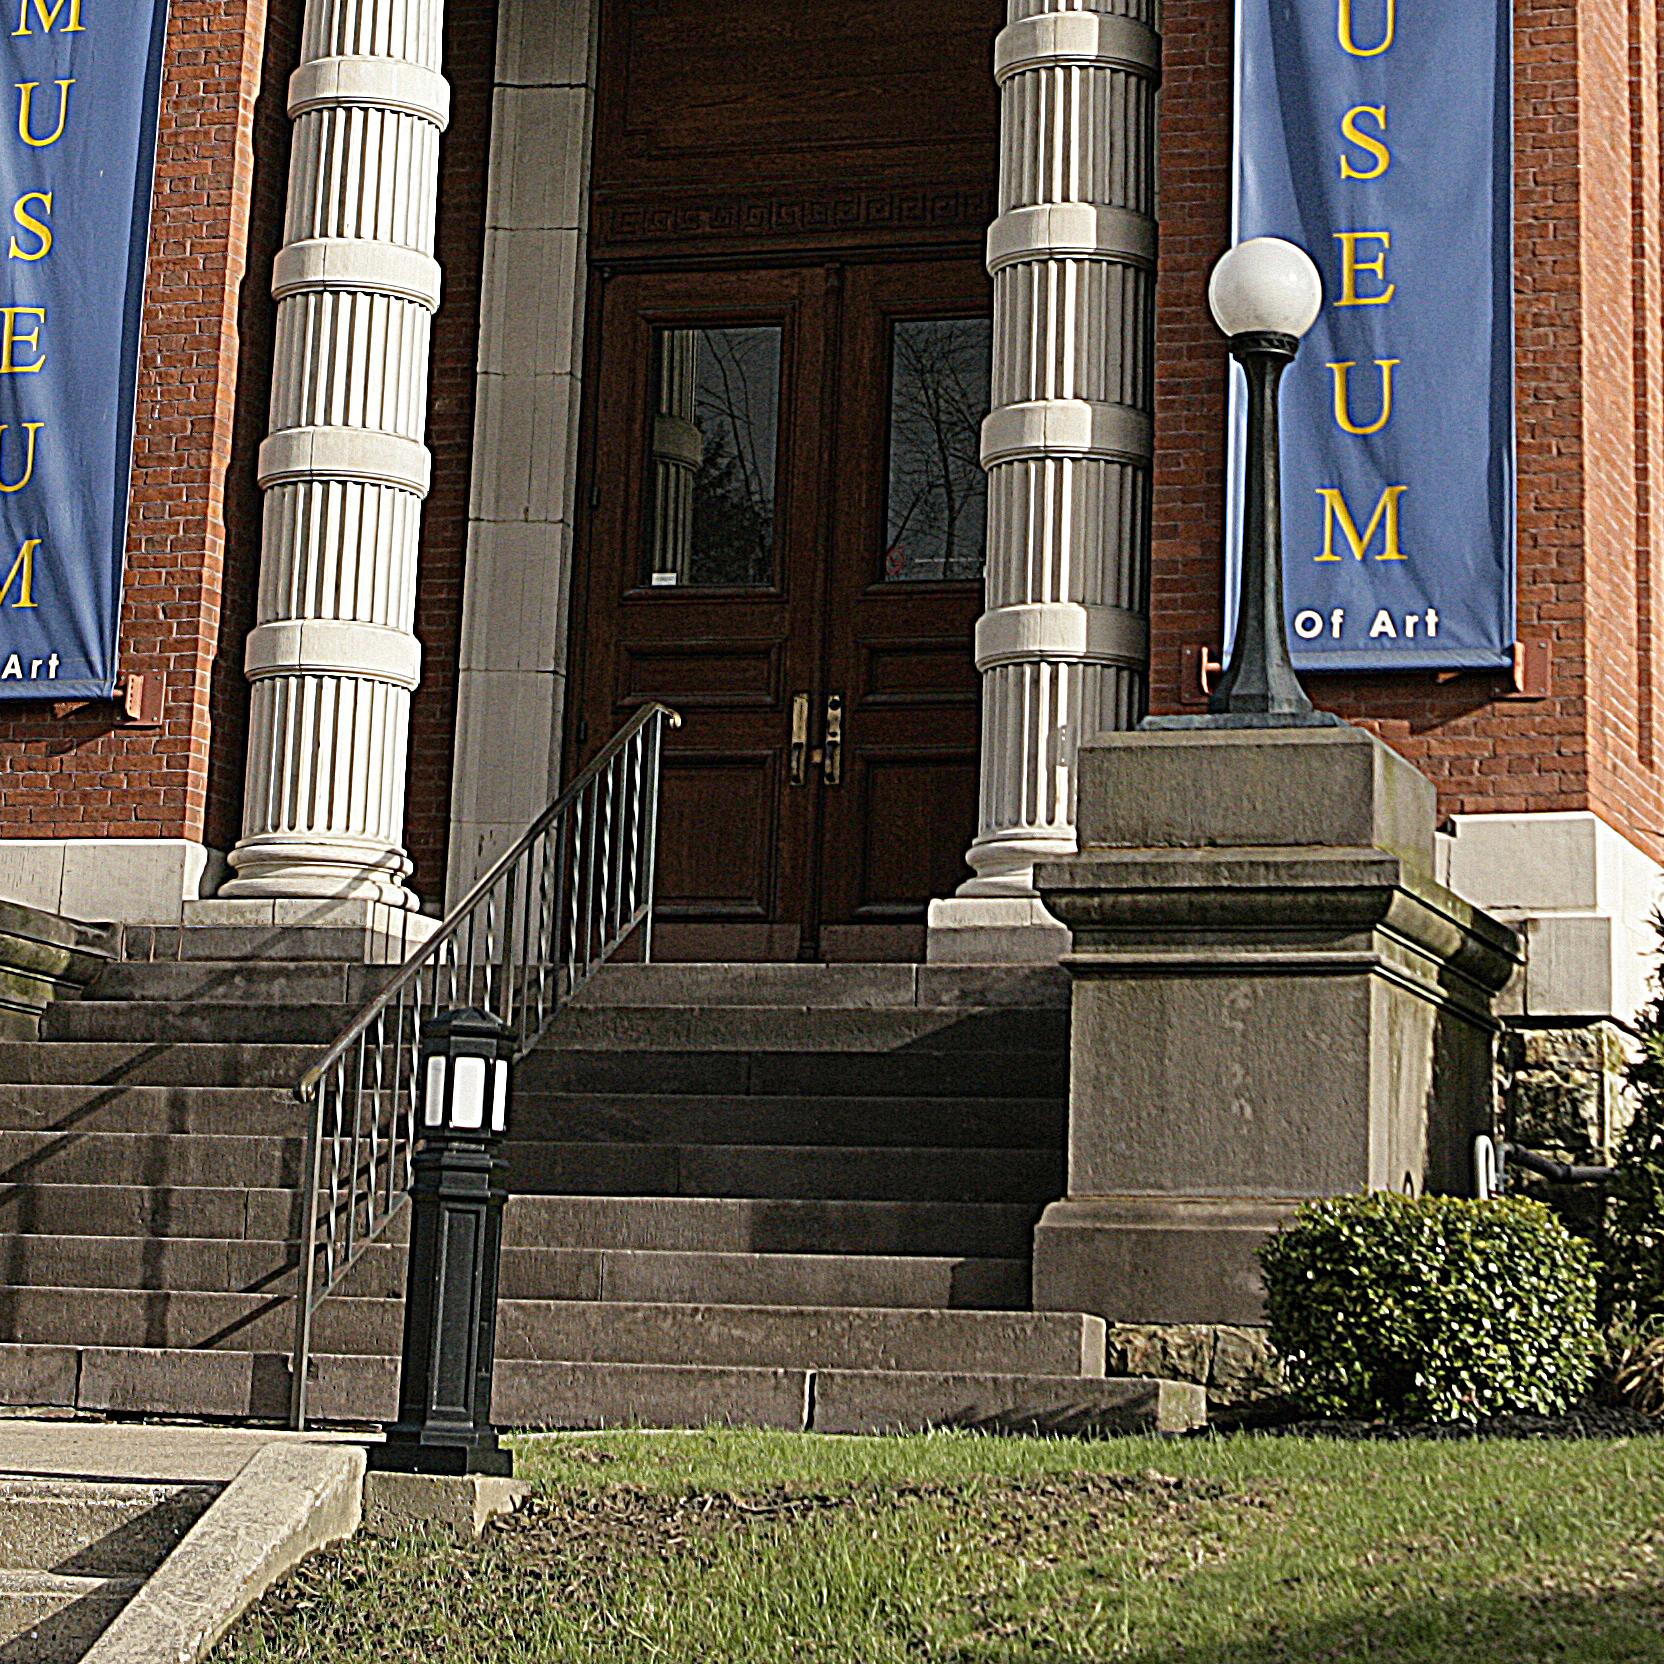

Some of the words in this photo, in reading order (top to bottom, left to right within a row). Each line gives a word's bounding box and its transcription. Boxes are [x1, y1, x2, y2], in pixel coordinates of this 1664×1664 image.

[1293, 608, 1344, 640] Of
[1368, 607, 1440, 639] Art
[0, 652, 61, 681] Art
